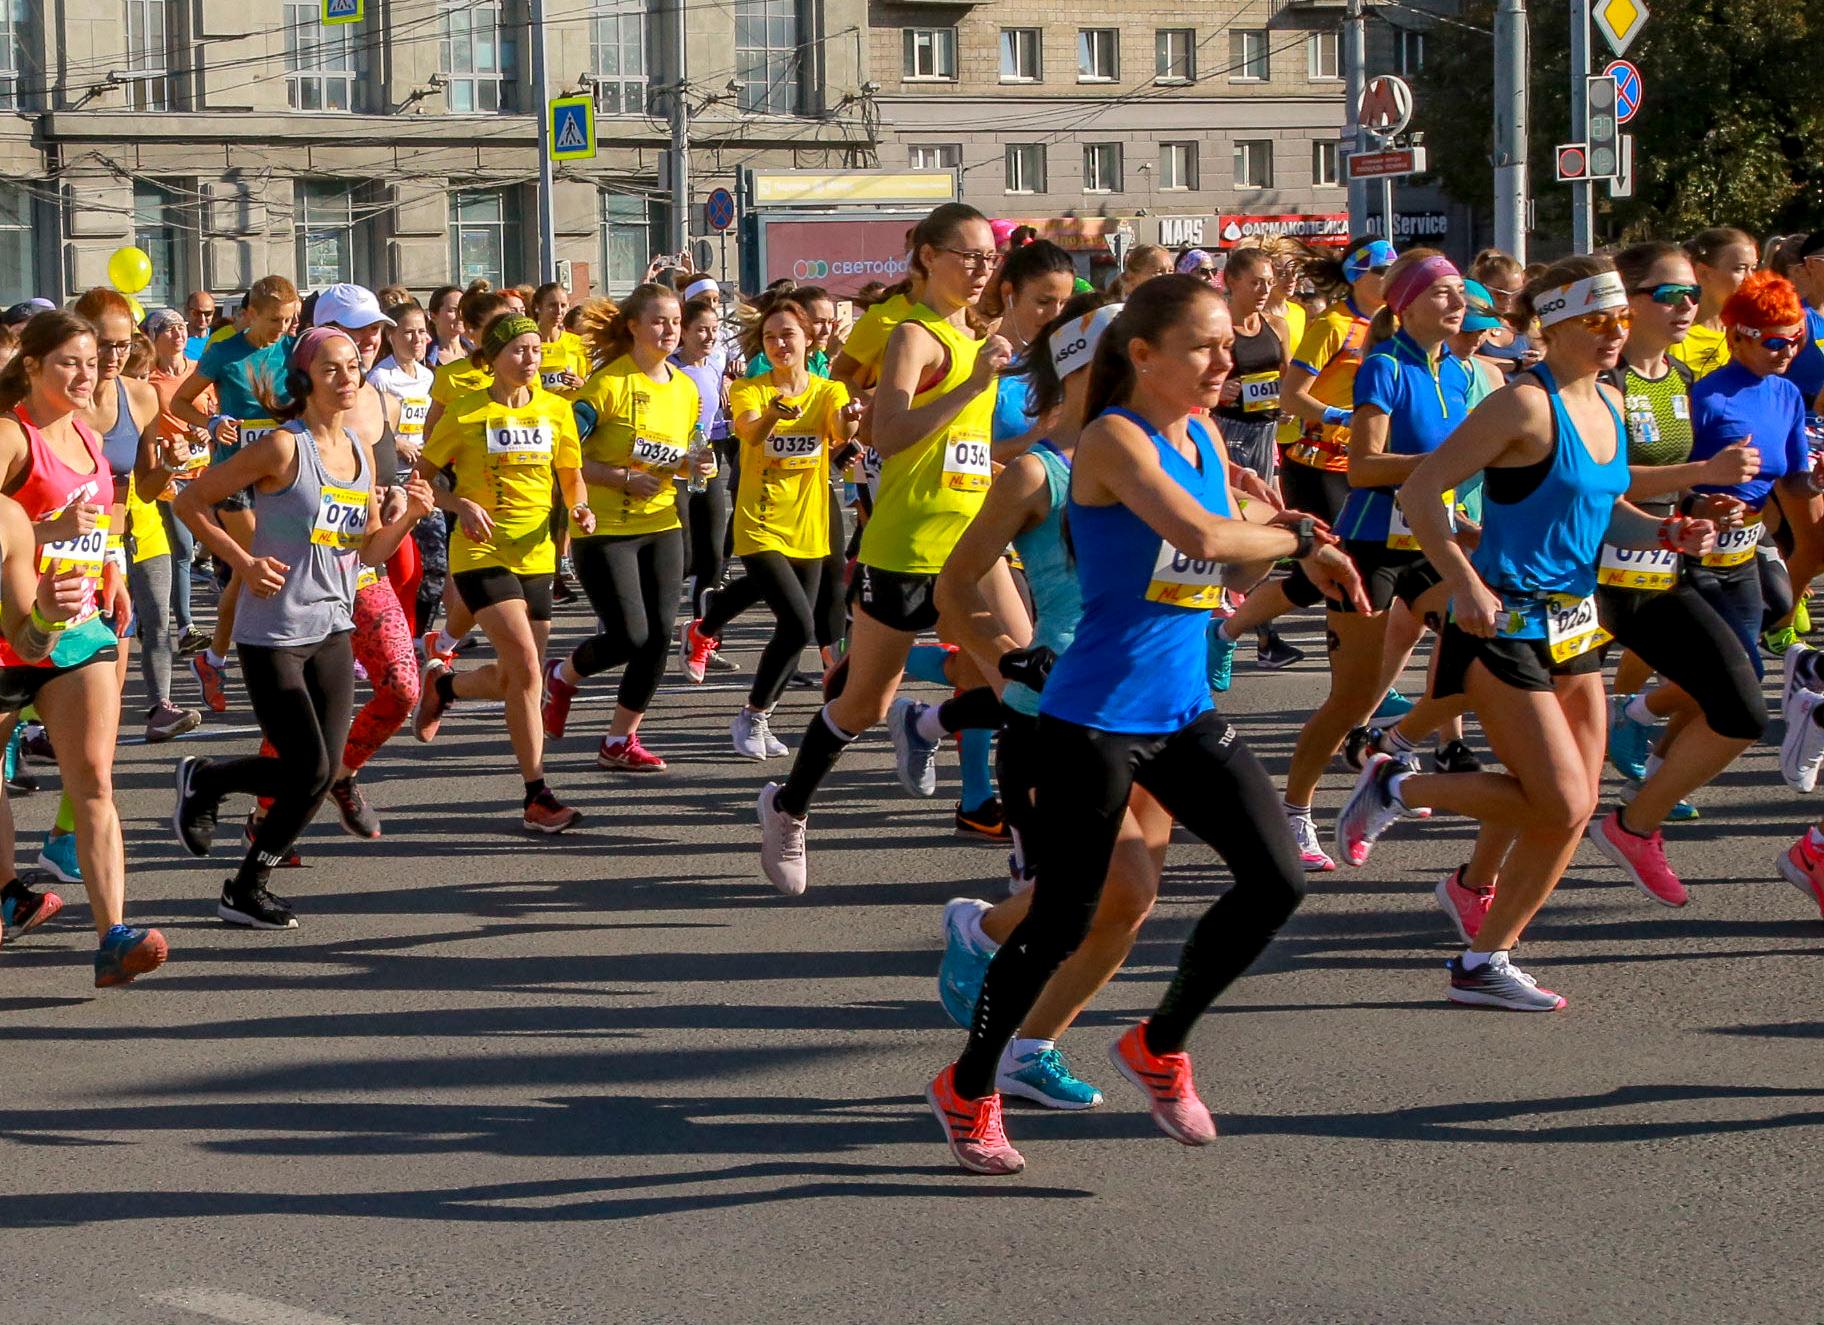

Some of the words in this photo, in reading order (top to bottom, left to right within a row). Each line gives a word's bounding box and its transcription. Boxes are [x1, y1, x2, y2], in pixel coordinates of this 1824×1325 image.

[1242, 219, 1349, 235] ФАРМАКОПЕЙКА
[1393, 213, 1448, 235] Service
[498, 429, 543, 446] 0116
[773, 437, 817, 452] 0325
[641, 443, 678, 462] 0326
